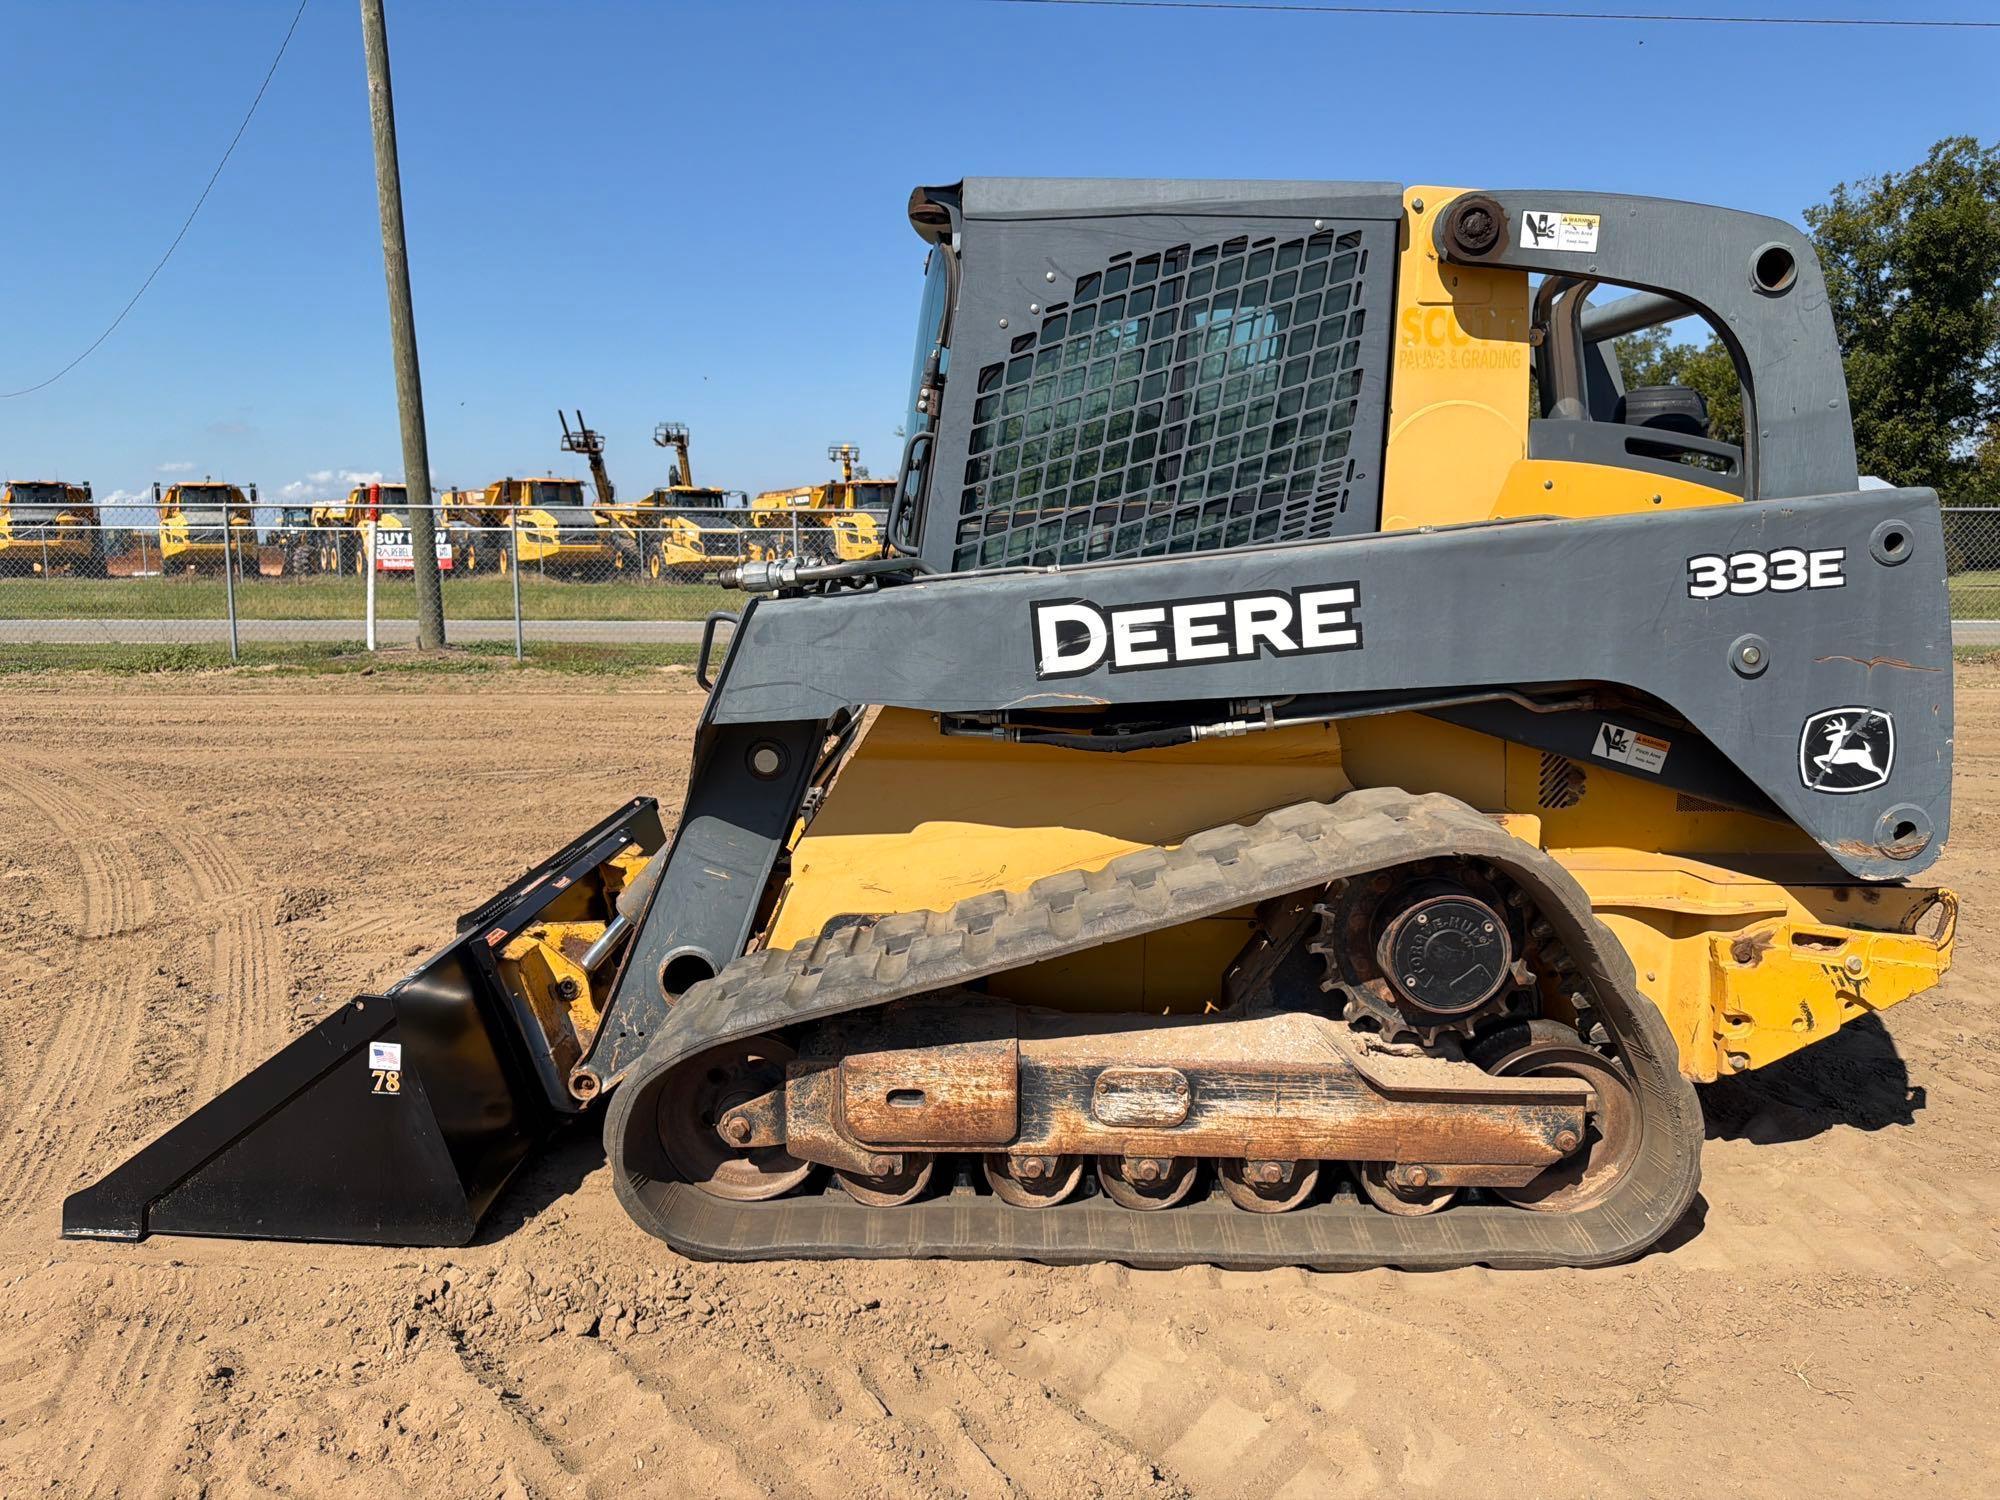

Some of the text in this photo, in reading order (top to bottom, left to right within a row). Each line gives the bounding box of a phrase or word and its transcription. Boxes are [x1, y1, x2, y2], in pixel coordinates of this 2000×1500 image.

[1462, 349, 1521, 369] GRADING
[376, 532, 404, 544] BUY
[1689, 549, 1845, 598] 333E
[1036, 587, 1358, 674] DEERE
